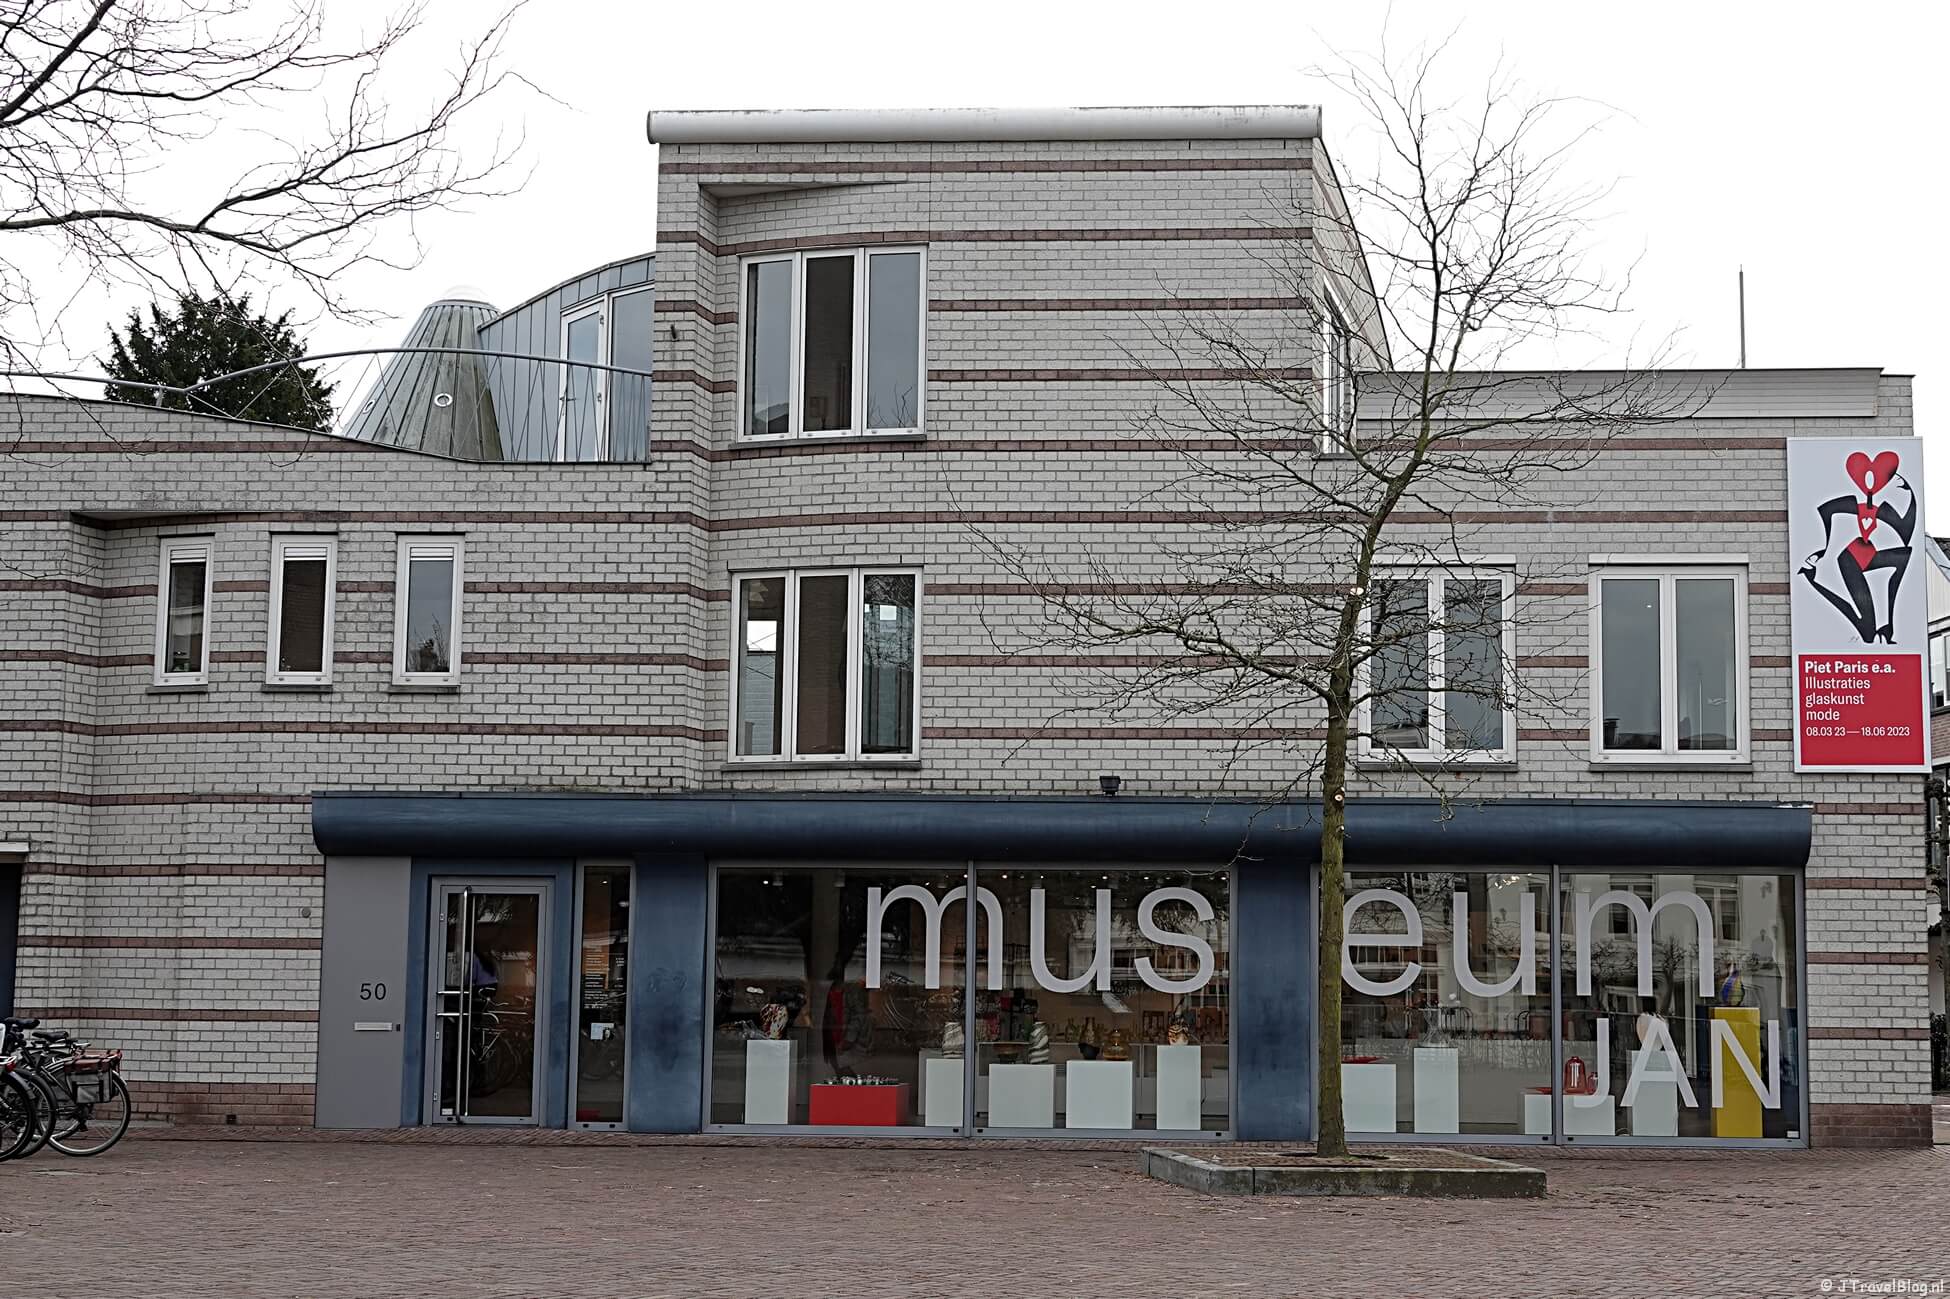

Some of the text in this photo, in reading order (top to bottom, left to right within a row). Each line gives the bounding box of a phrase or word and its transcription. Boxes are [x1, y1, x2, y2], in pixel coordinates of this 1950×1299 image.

[1804, 661, 1896, 673] Piet Paris e.a.
[1805, 676, 1871, 689] Illustraties
[1805, 692, 1864, 708] glaskunst
[1806, 708, 1840, 721] mode
[1805, 726, 1833, 737] 08.03
[1887, 726, 1911, 737] 2023
[360, 982, 387, 1001] 50
[1573, 1016, 1782, 1110] JAN
